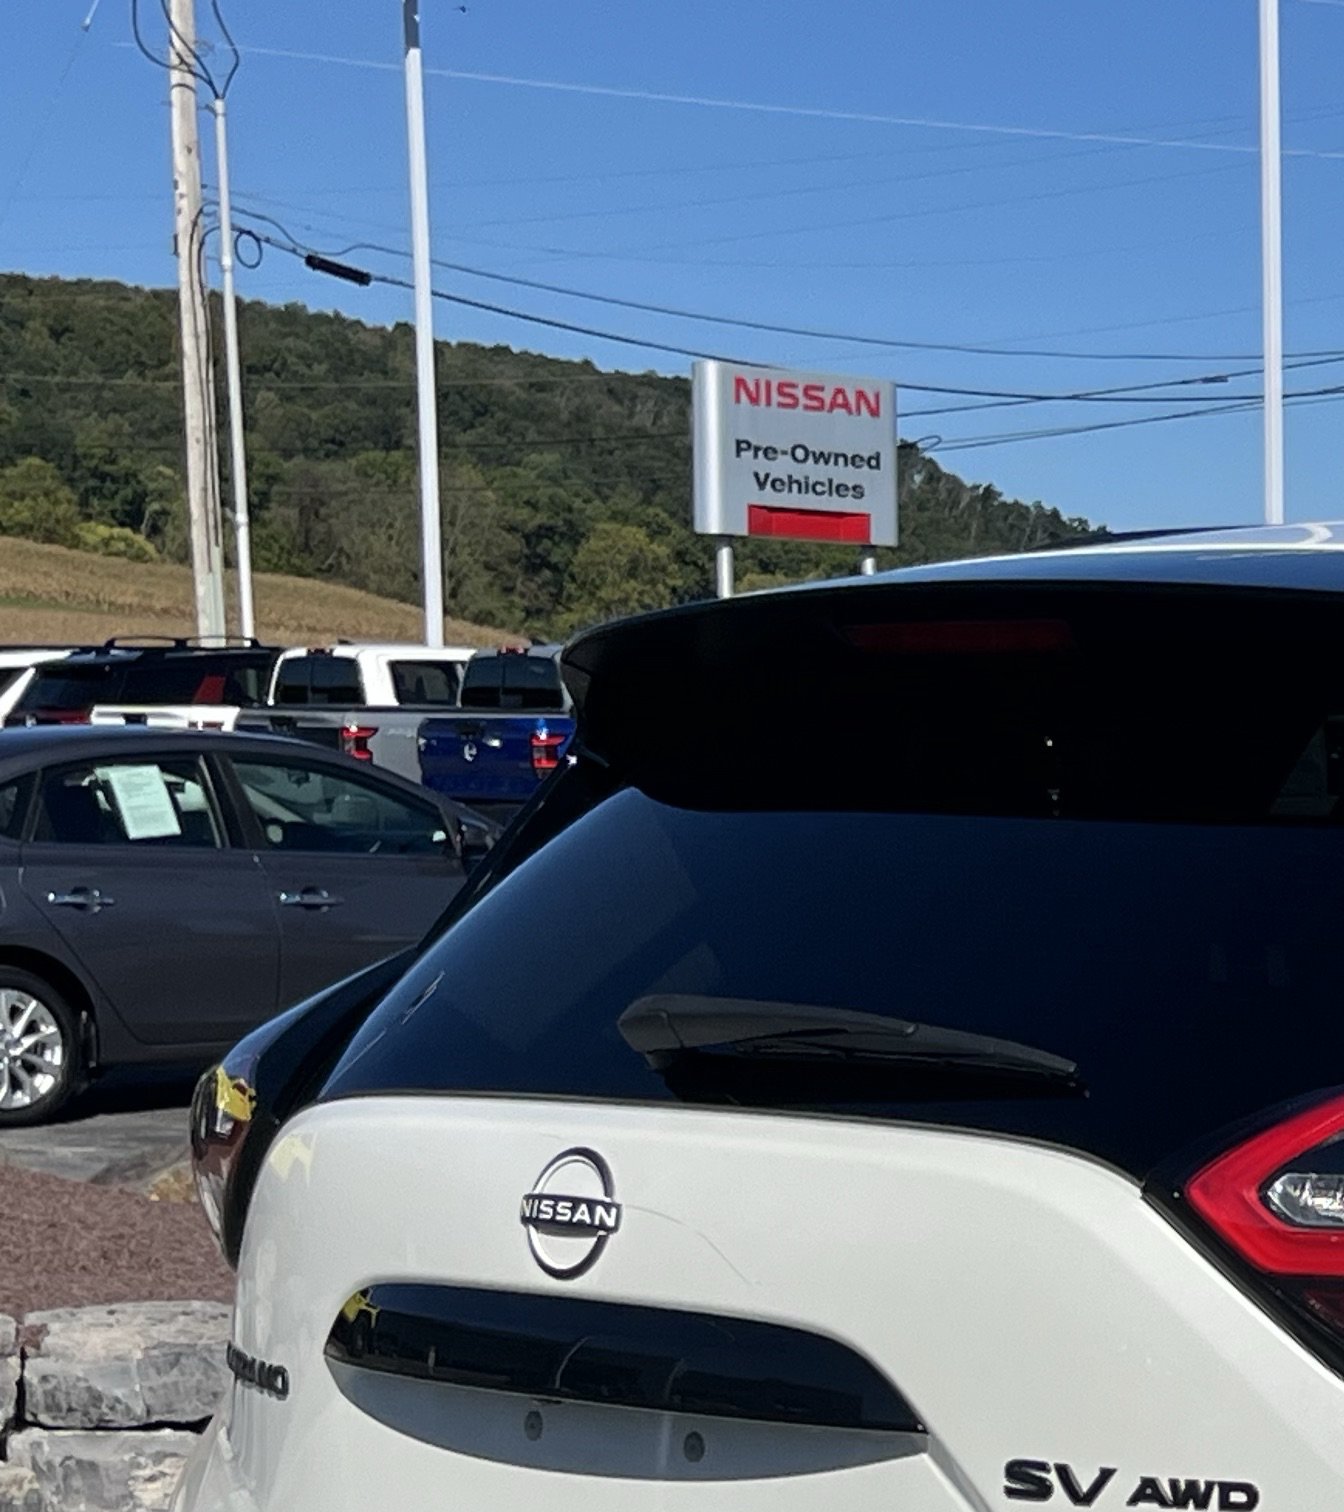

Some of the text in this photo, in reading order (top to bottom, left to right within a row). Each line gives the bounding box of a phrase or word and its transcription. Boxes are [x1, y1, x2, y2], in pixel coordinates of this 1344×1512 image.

[734, 376, 881, 419] NISSAN
[735, 438, 882, 471] Pre-Owned
[753, 471, 865, 500] Vehicles
[520, 1198, 617, 1228] NISSAN
[1003, 1458, 1260, 1512] SV AWD
